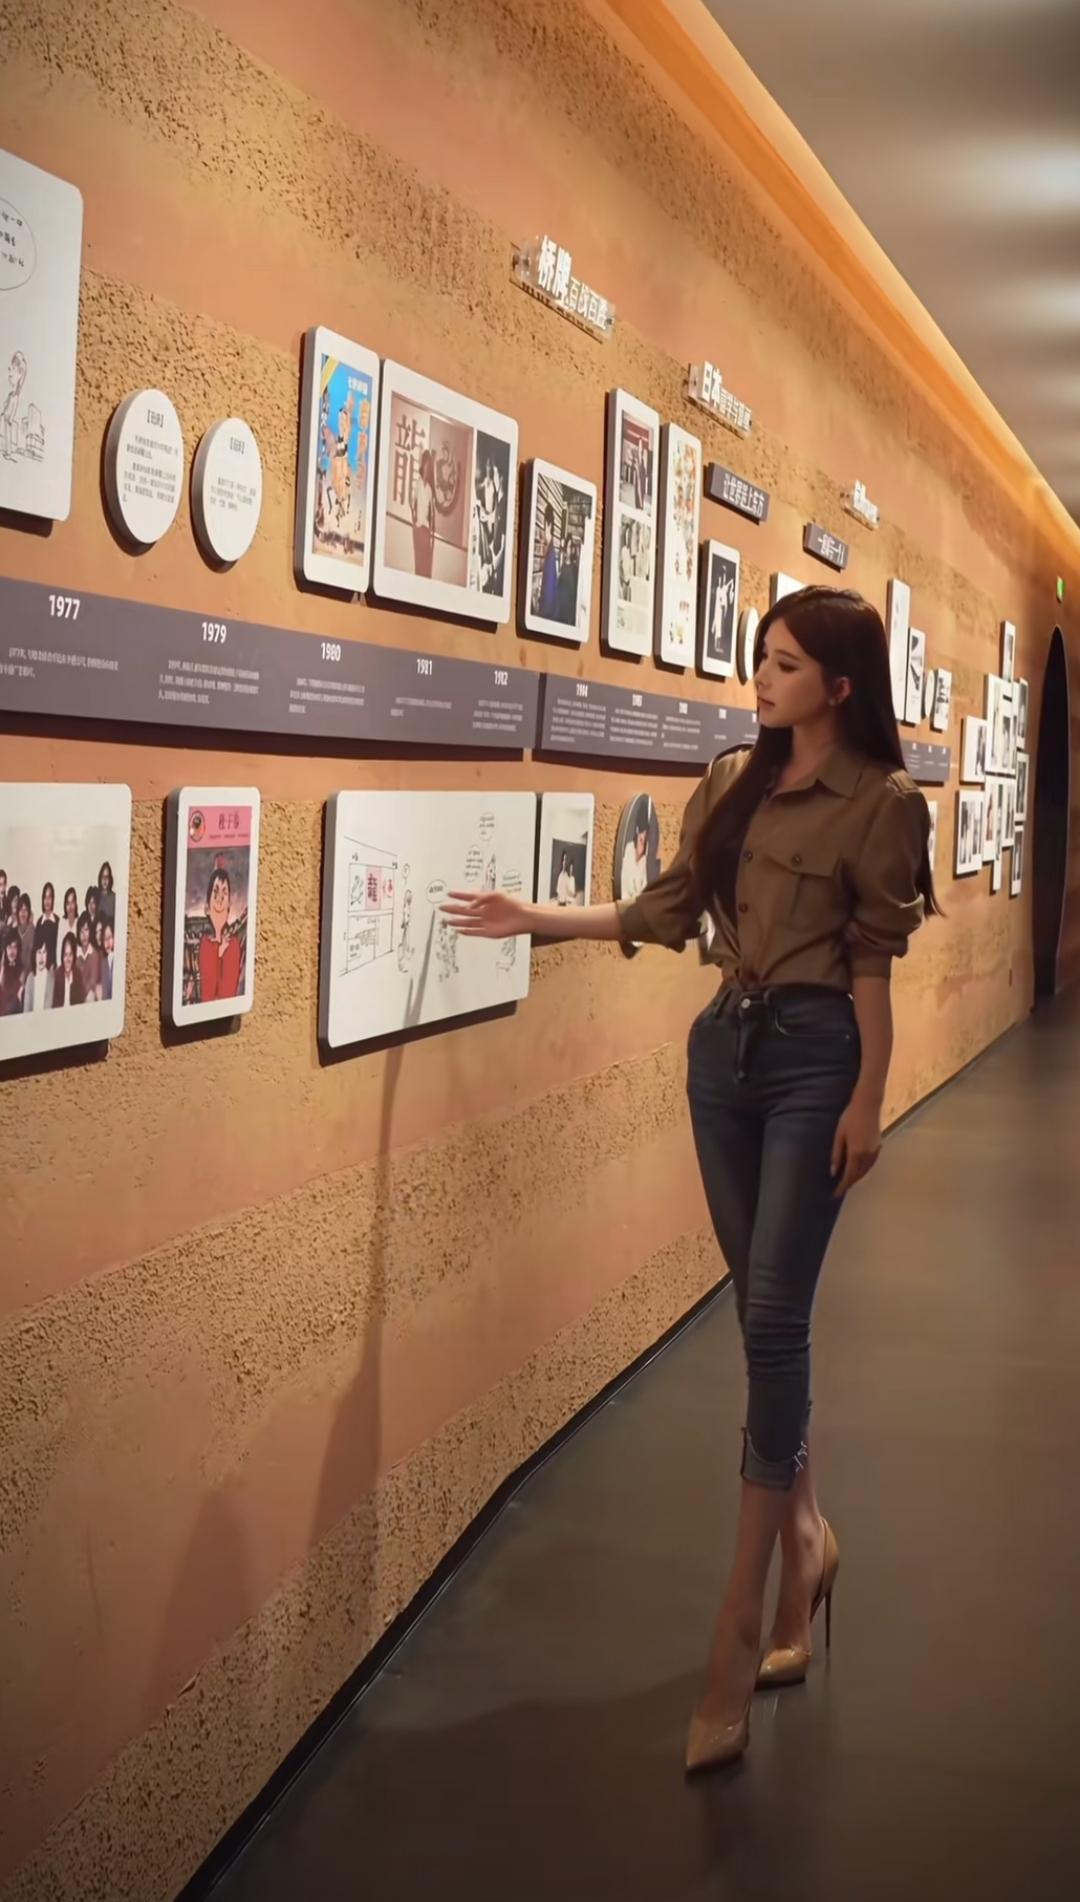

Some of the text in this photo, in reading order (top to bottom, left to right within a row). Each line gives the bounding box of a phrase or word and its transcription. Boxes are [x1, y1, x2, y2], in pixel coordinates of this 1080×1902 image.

[49, 595, 81, 620] 1977
[202, 622, 227, 643] 1979
[321, 642, 342, 662] 1980
